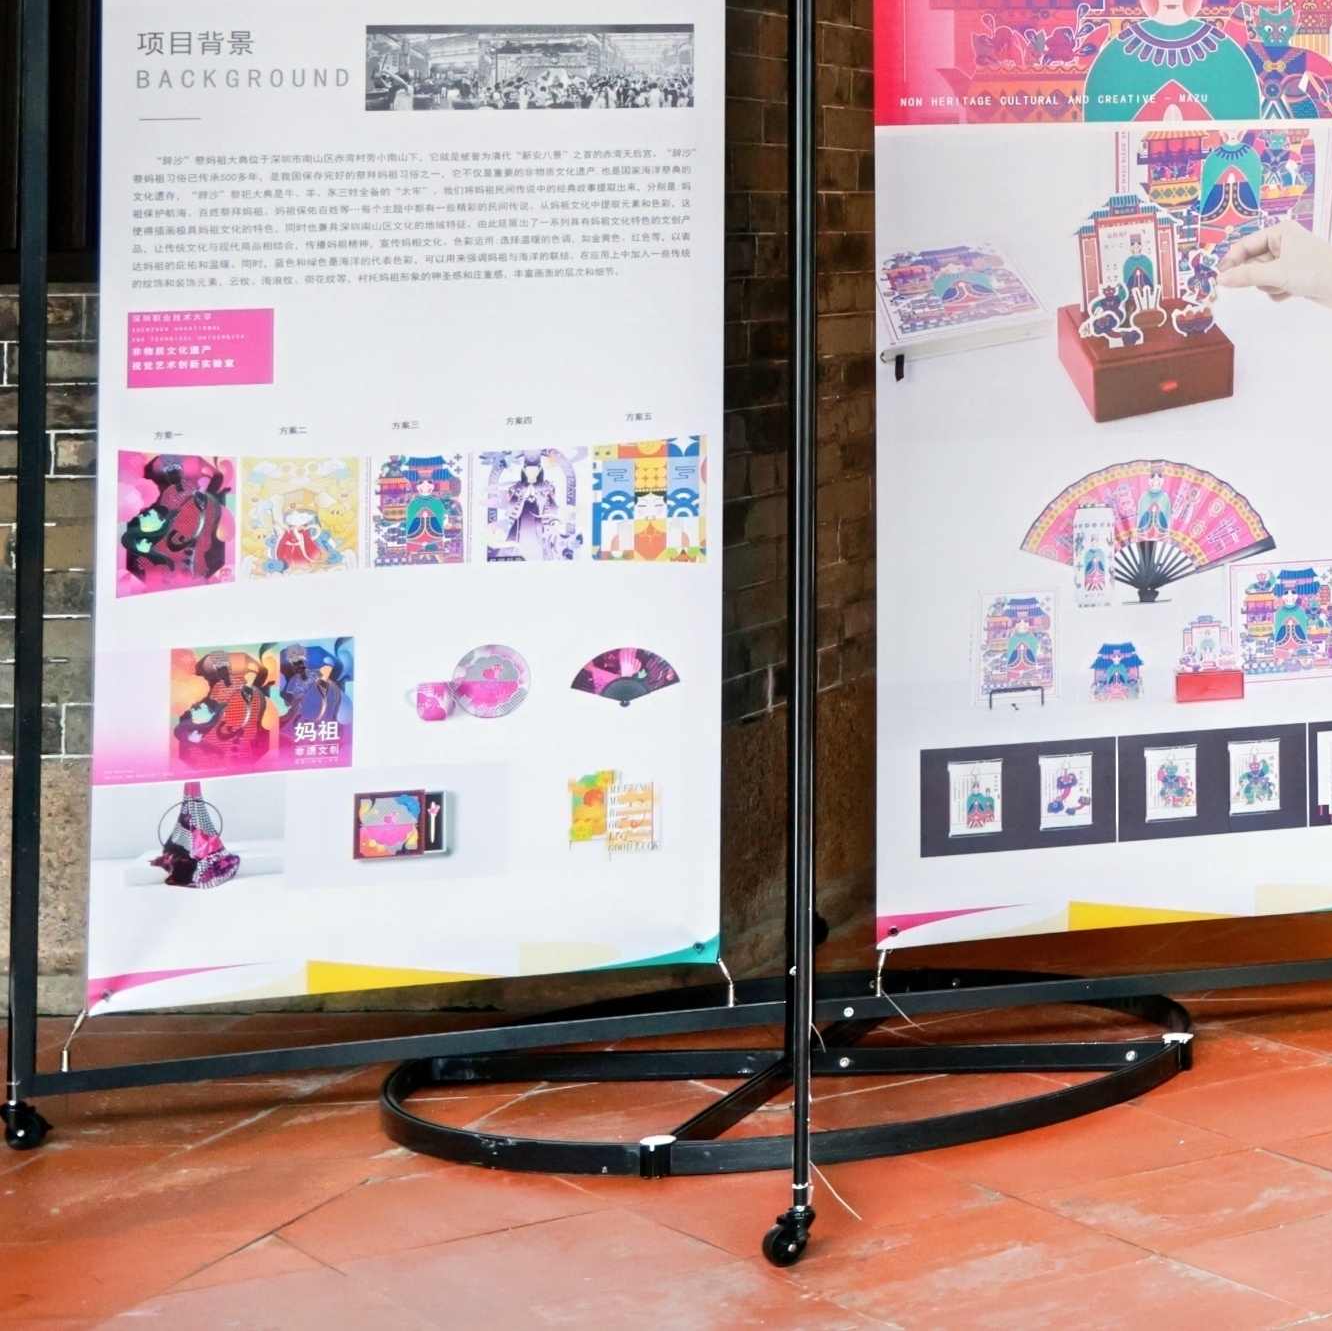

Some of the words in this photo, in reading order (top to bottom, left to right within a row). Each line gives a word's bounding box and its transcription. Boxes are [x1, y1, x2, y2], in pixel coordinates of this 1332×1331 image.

[137, 30, 255, 56] 项目背景
[136, 69, 350, 90] BACKGROUND
[900, 97, 923, 107] NON
[931, 96, 992, 107] HERITAGE
[1000, 95, 1059, 106] CULTURAL
[1068, 95, 1090, 105] AND
[1098, 94, 1156, 104] CREATIVE
[1179, 93, 1208, 103] MAZU
[132, 345, 212, 356] 非物质文化遗产
[132, 359, 234, 371] 视觉艺术创新实验室
[506, 416, 532, 425] 方案四
[625, 411, 653, 422] 方案五
[279, 425, 307, 436] 方案二
[392, 421, 420, 430] 方案三
[154, 430, 183, 440] 方案一
[294, 721, 340, 742] 妈祖
